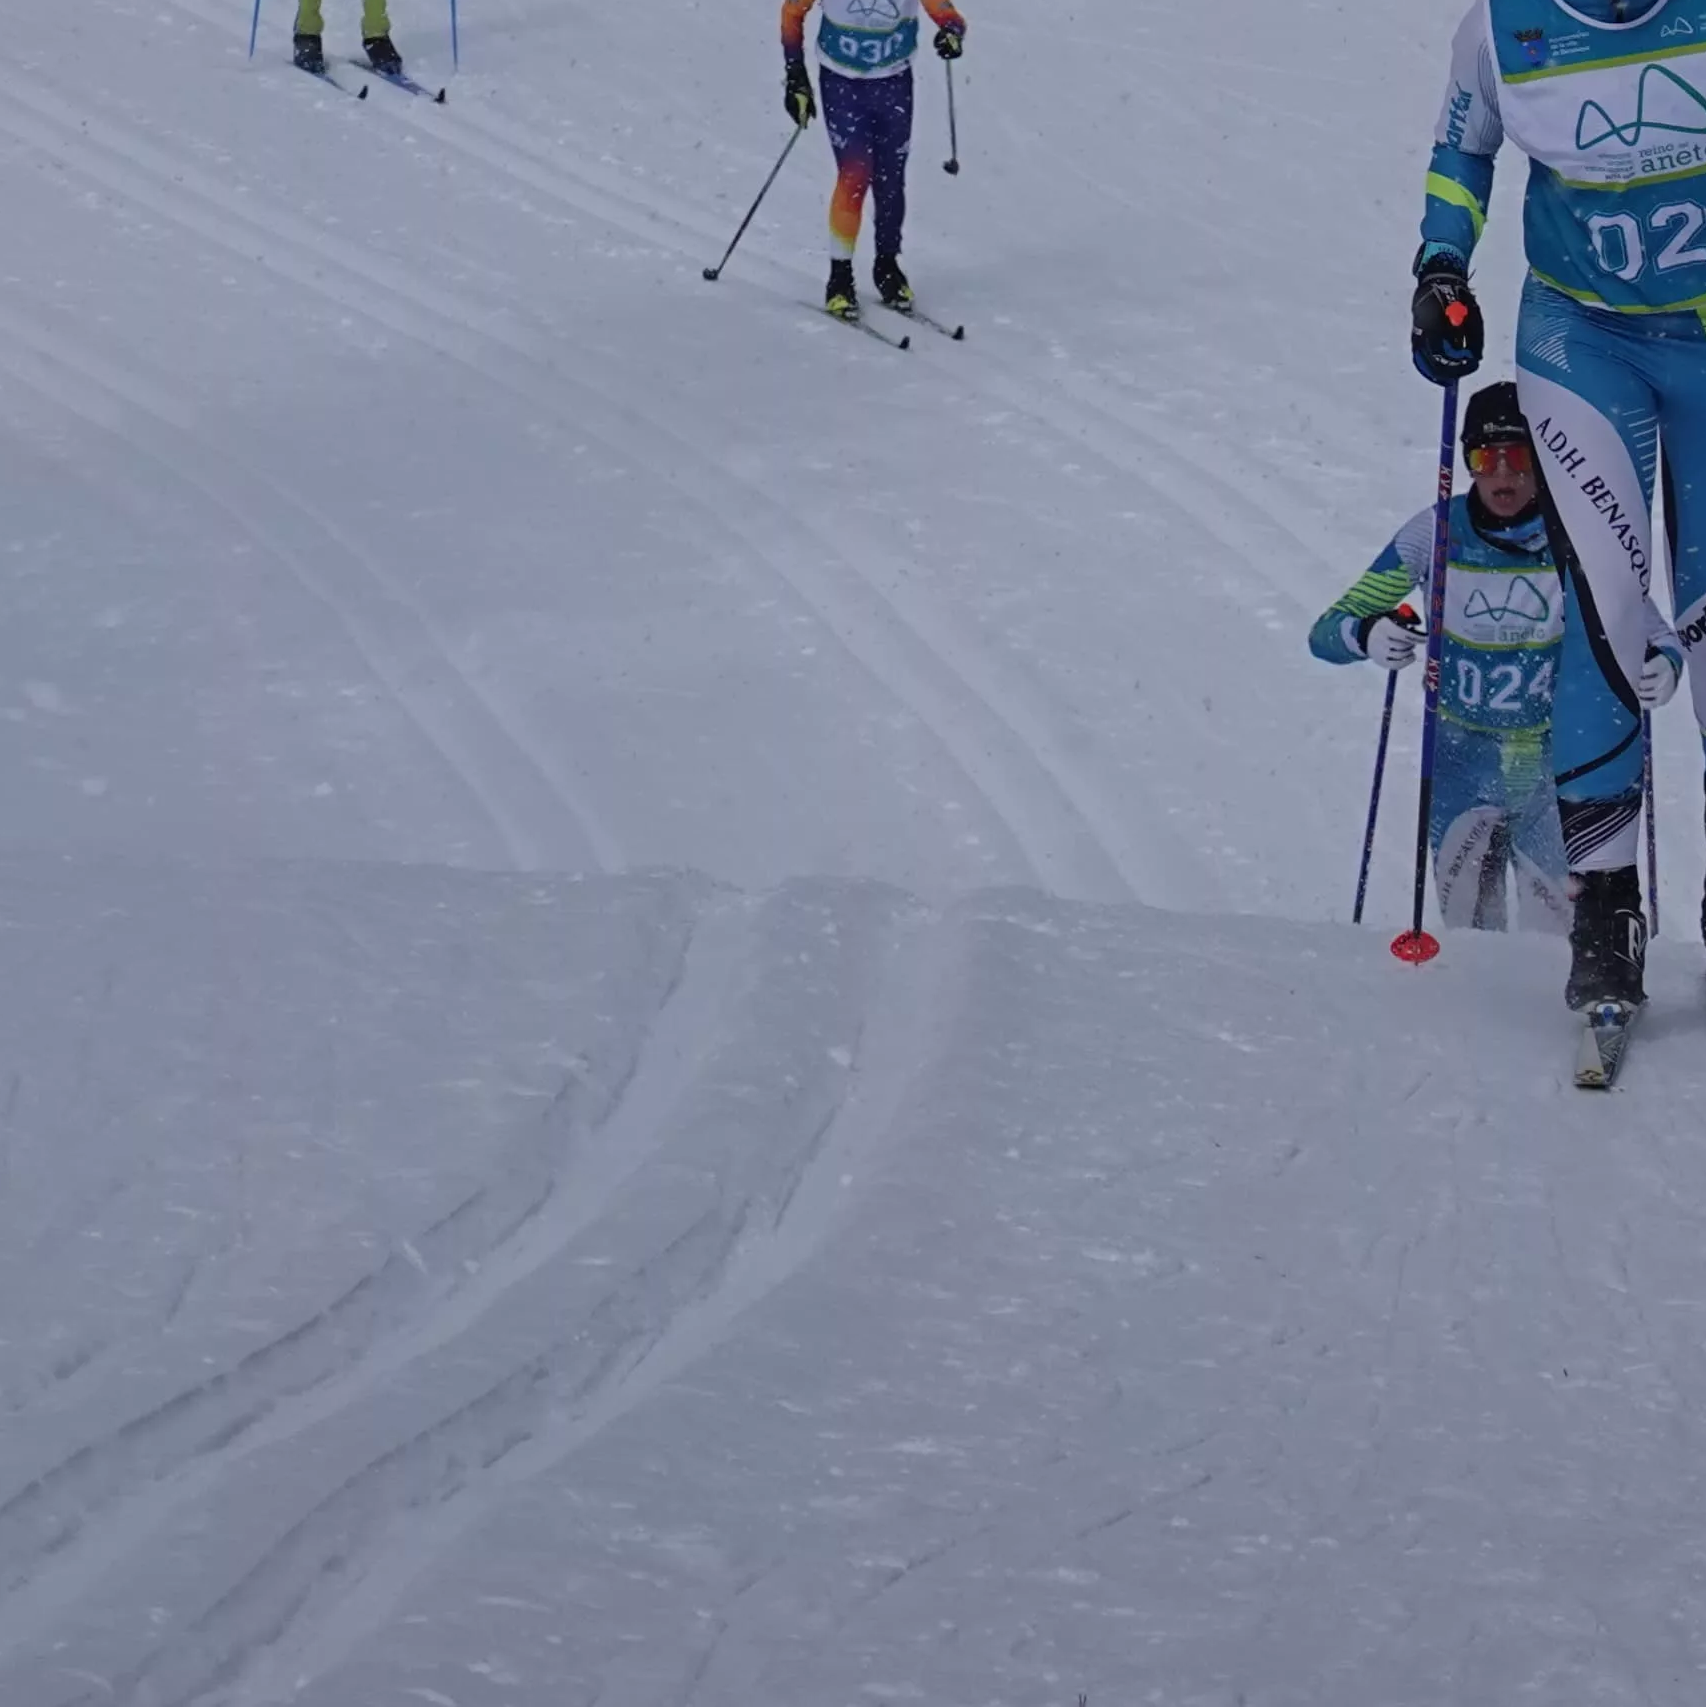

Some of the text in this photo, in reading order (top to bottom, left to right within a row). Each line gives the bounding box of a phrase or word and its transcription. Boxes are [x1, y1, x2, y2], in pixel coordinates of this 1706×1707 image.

[1637, 143, 1675, 158] reino
[1535, 416, 1587, 480] A.D.H.
[1457, 658, 1556, 711] 024
